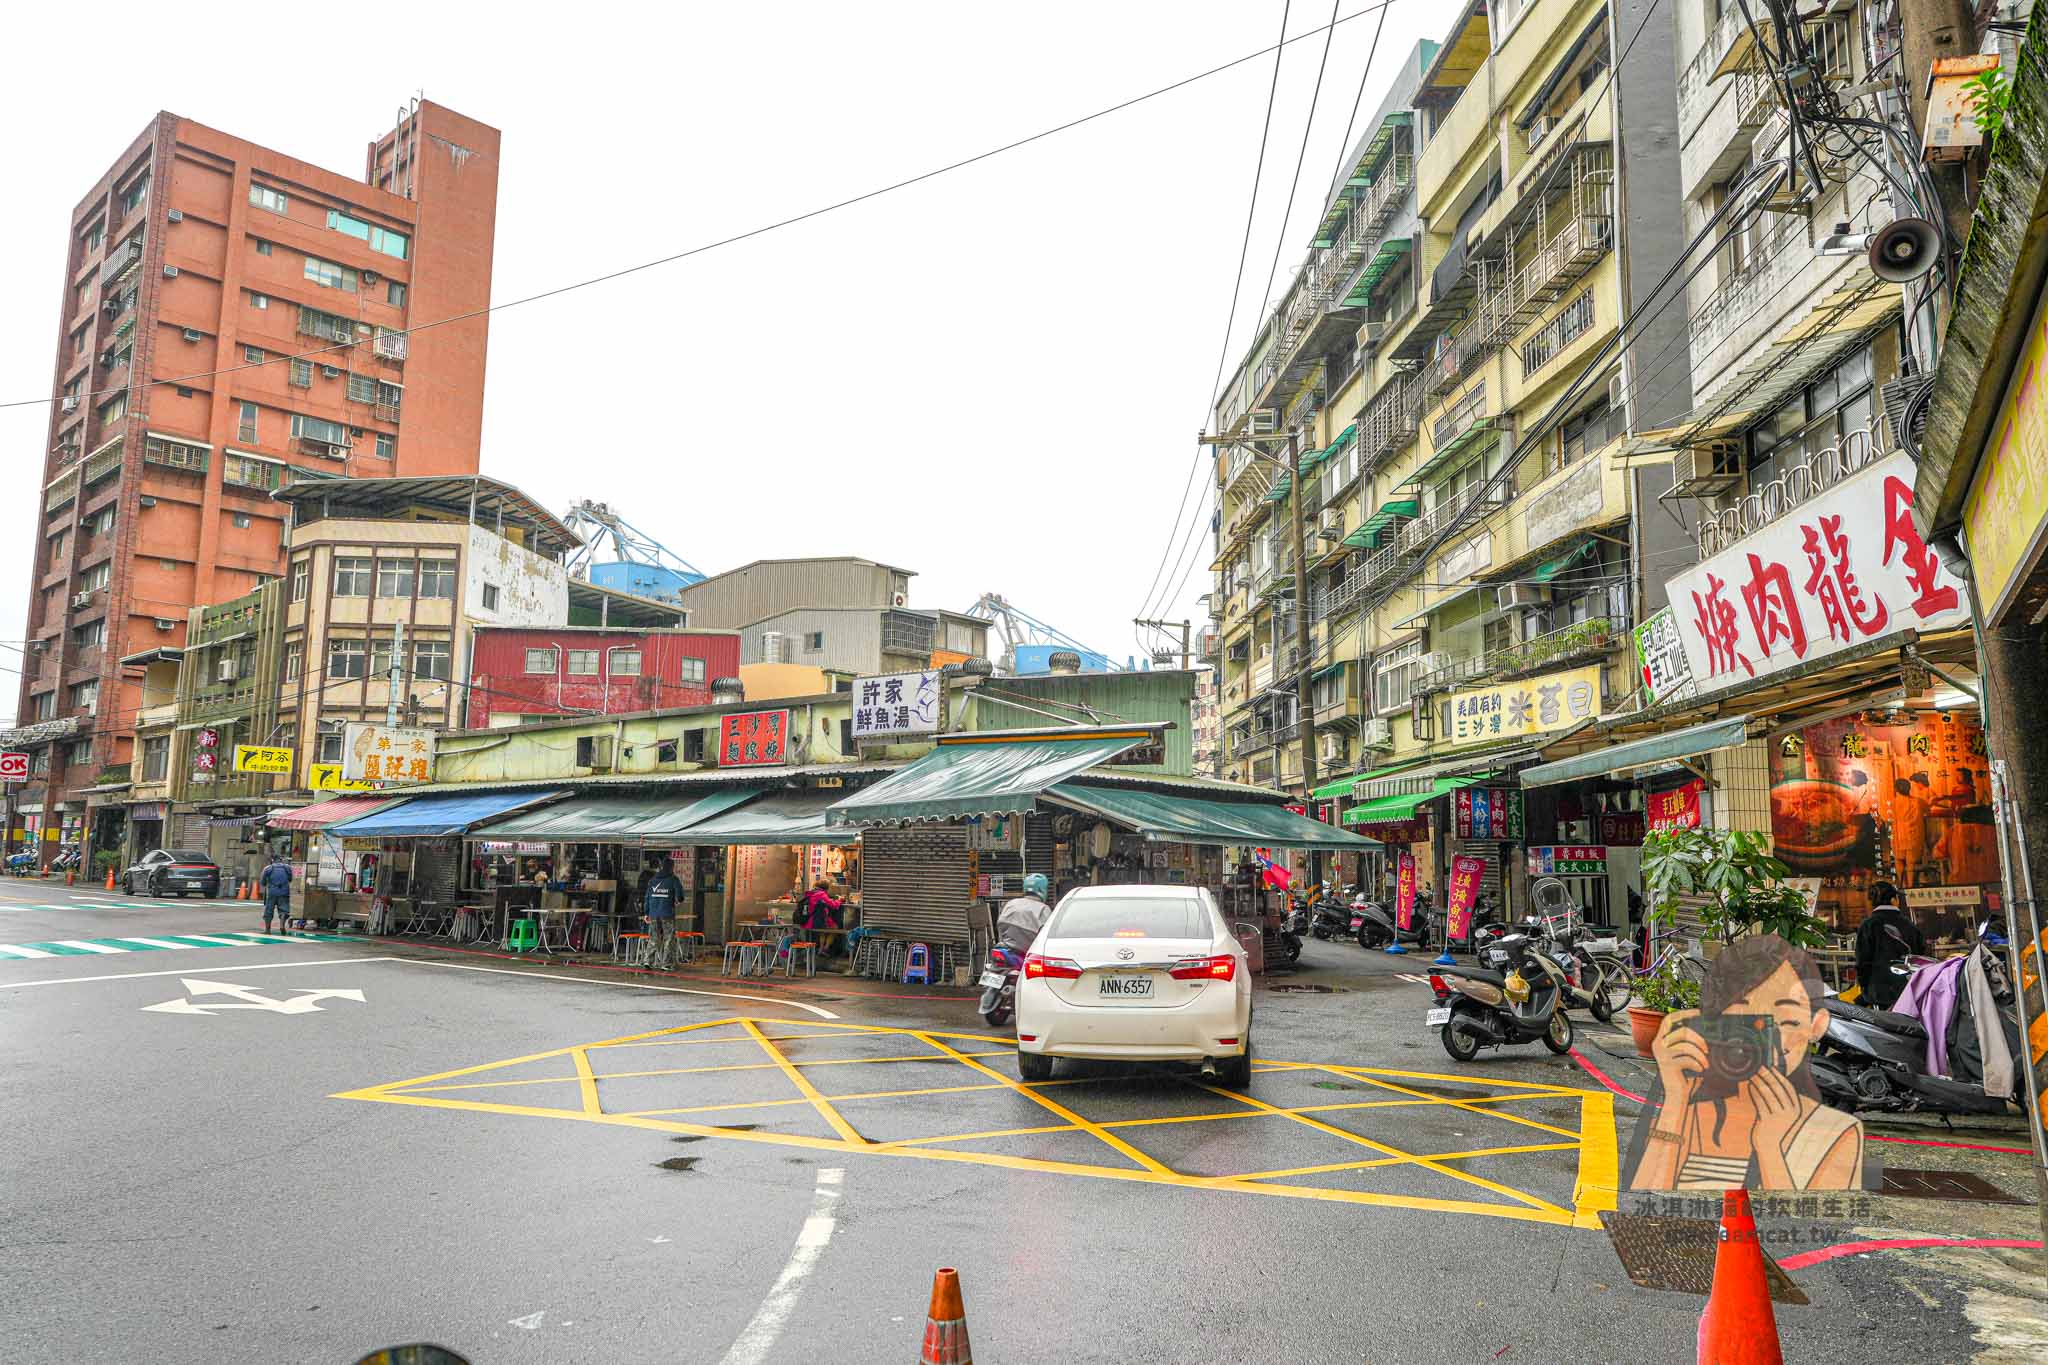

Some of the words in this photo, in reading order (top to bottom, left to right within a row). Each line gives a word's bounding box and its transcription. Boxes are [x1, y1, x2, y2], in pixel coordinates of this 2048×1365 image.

[863, 678, 902, 706] 許家
[1508, 680, 1594, 729] 米苔目
[857, 705, 909, 731] 鮮魚湯
[1457, 713, 1501, 737] 三沙灣
[376, 736, 428, 753] 第一家
[1, 759, 27, 772] OK
